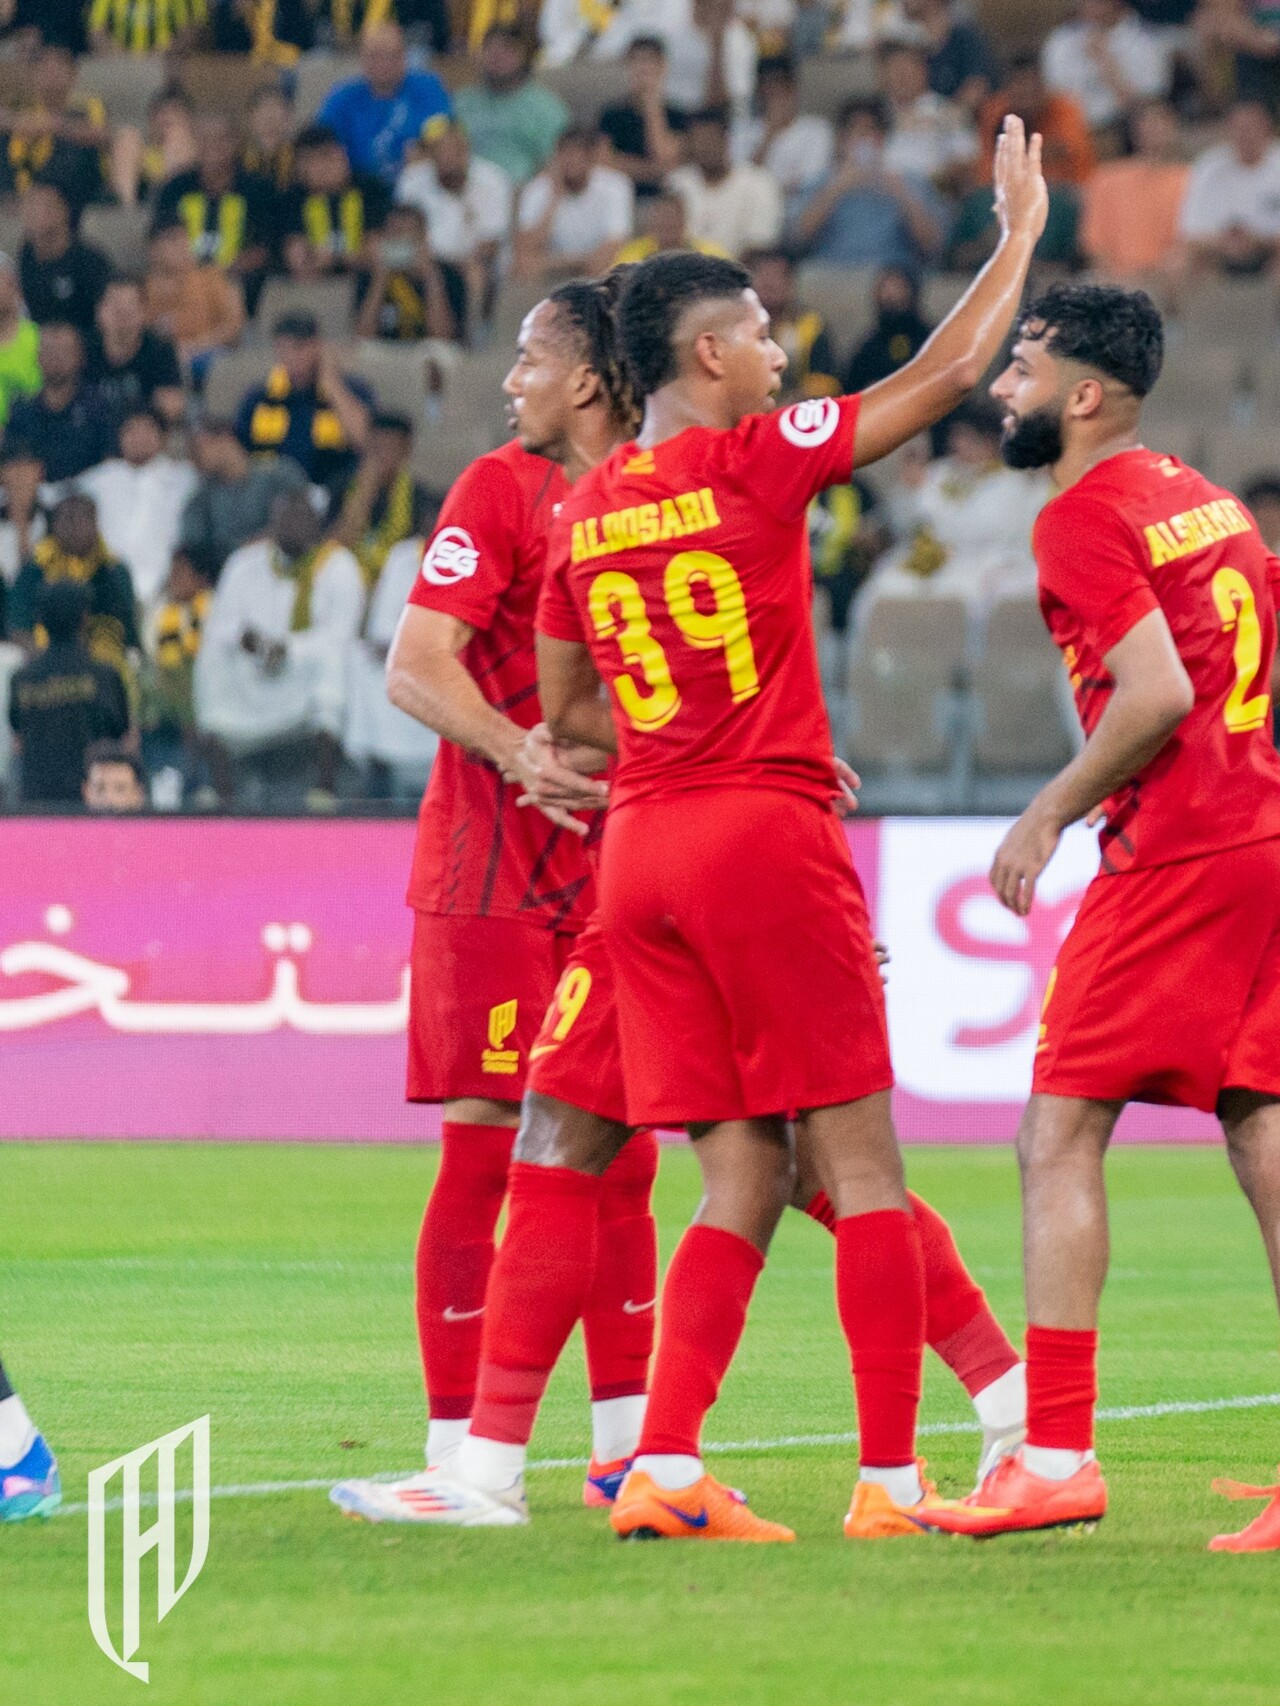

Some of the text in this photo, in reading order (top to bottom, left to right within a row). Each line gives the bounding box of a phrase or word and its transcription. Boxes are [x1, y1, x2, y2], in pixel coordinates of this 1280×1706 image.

[571, 487, 721, 563] ALDOSARI
[588, 551, 760, 732] 39
[1212, 567, 1270, 734] 2
